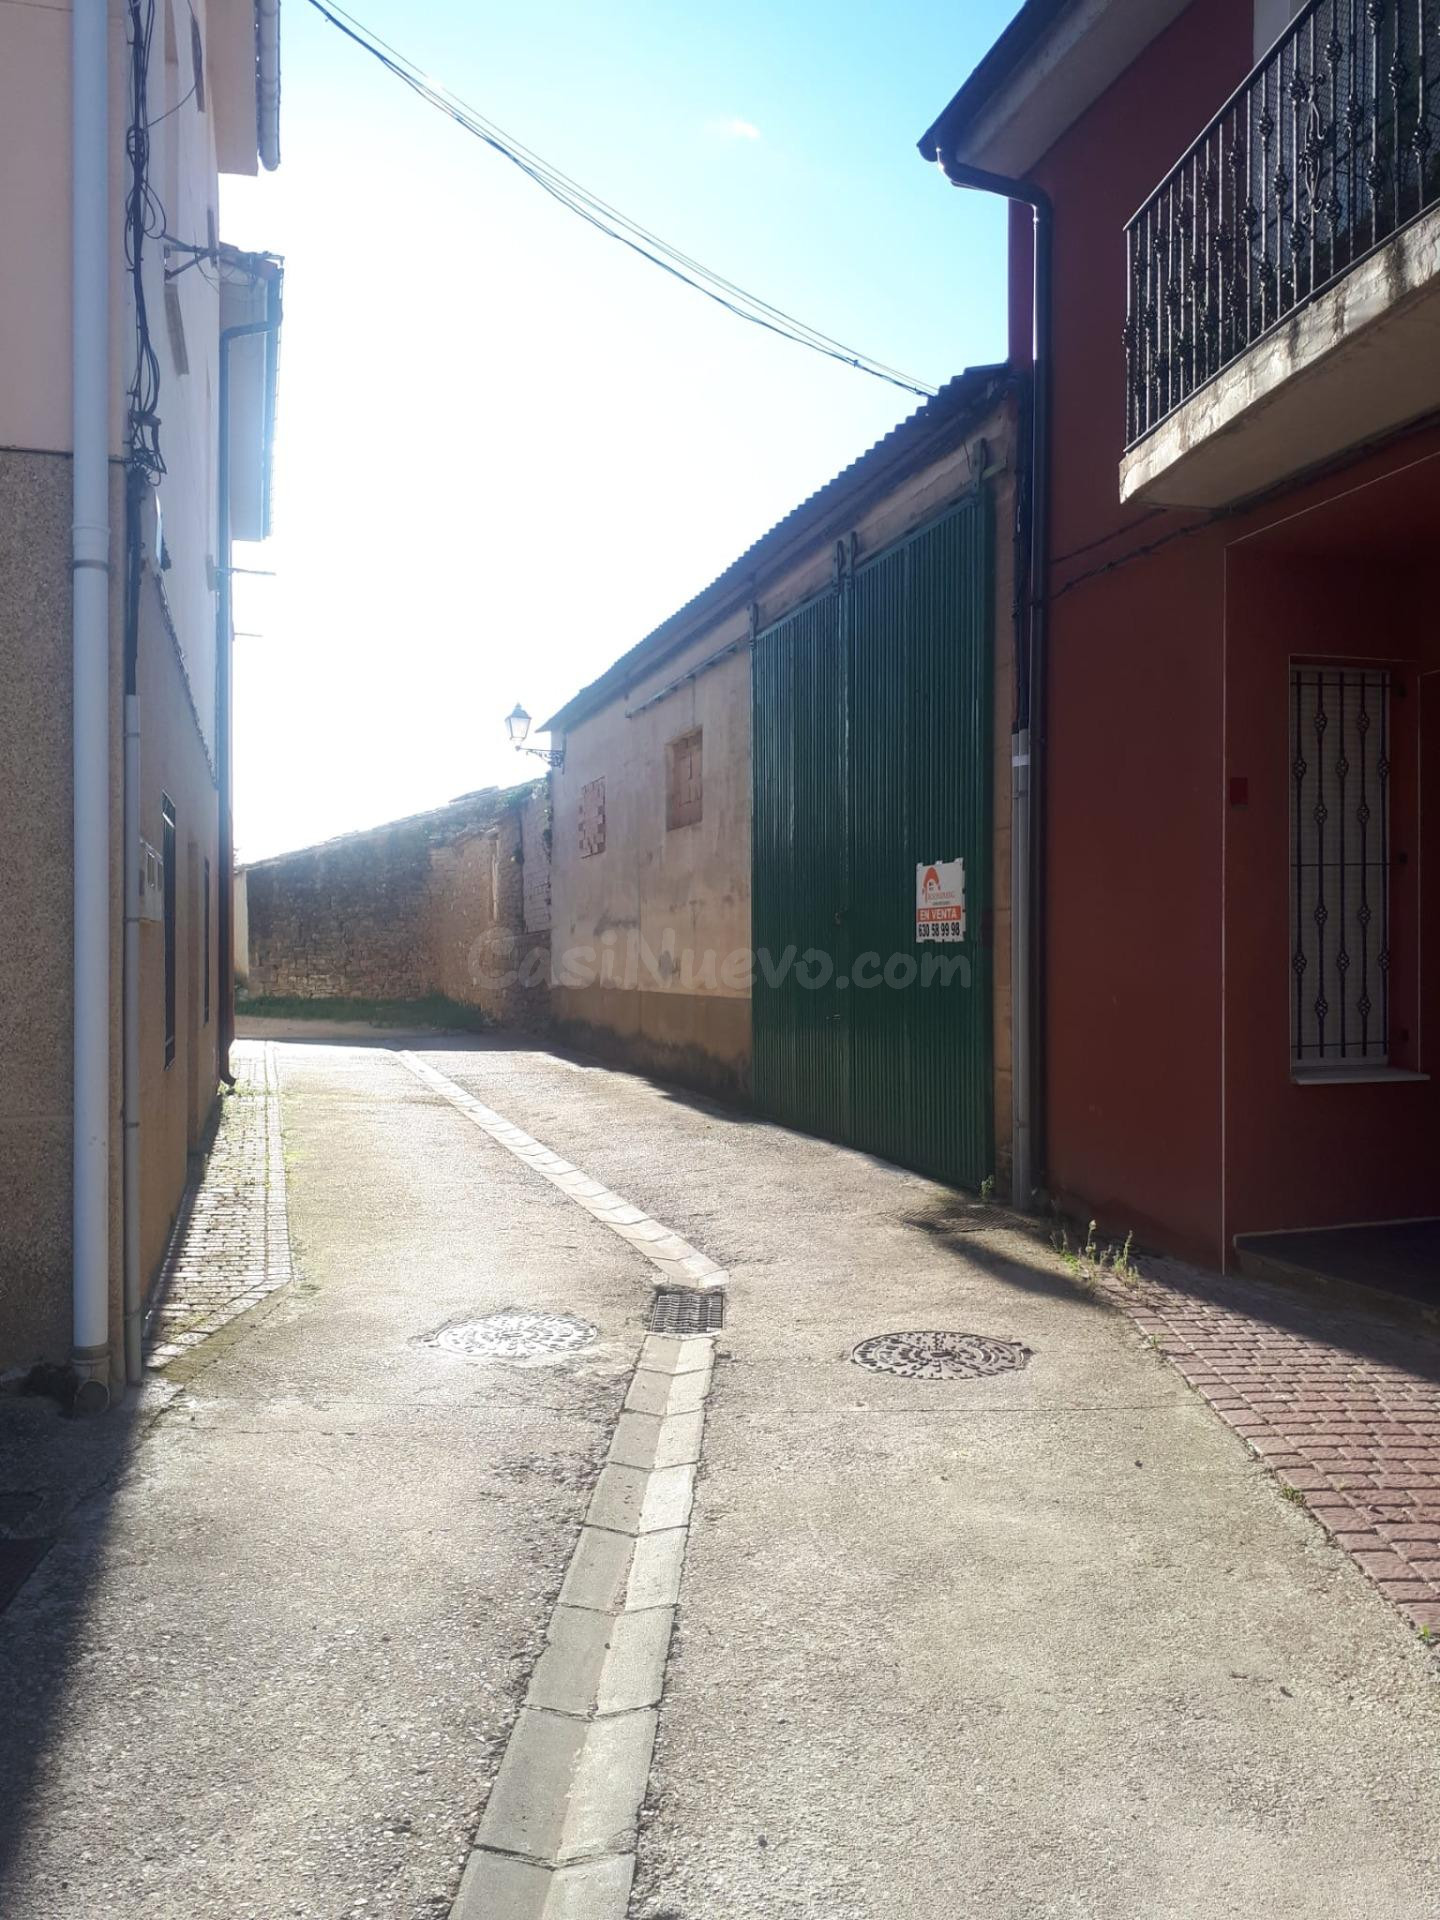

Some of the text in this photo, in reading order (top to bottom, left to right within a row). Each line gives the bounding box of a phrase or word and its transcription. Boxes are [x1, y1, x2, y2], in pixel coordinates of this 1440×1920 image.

[919, 907, 957, 921] EN VENTA
[918, 921, 960, 937] 630 58 99 98
